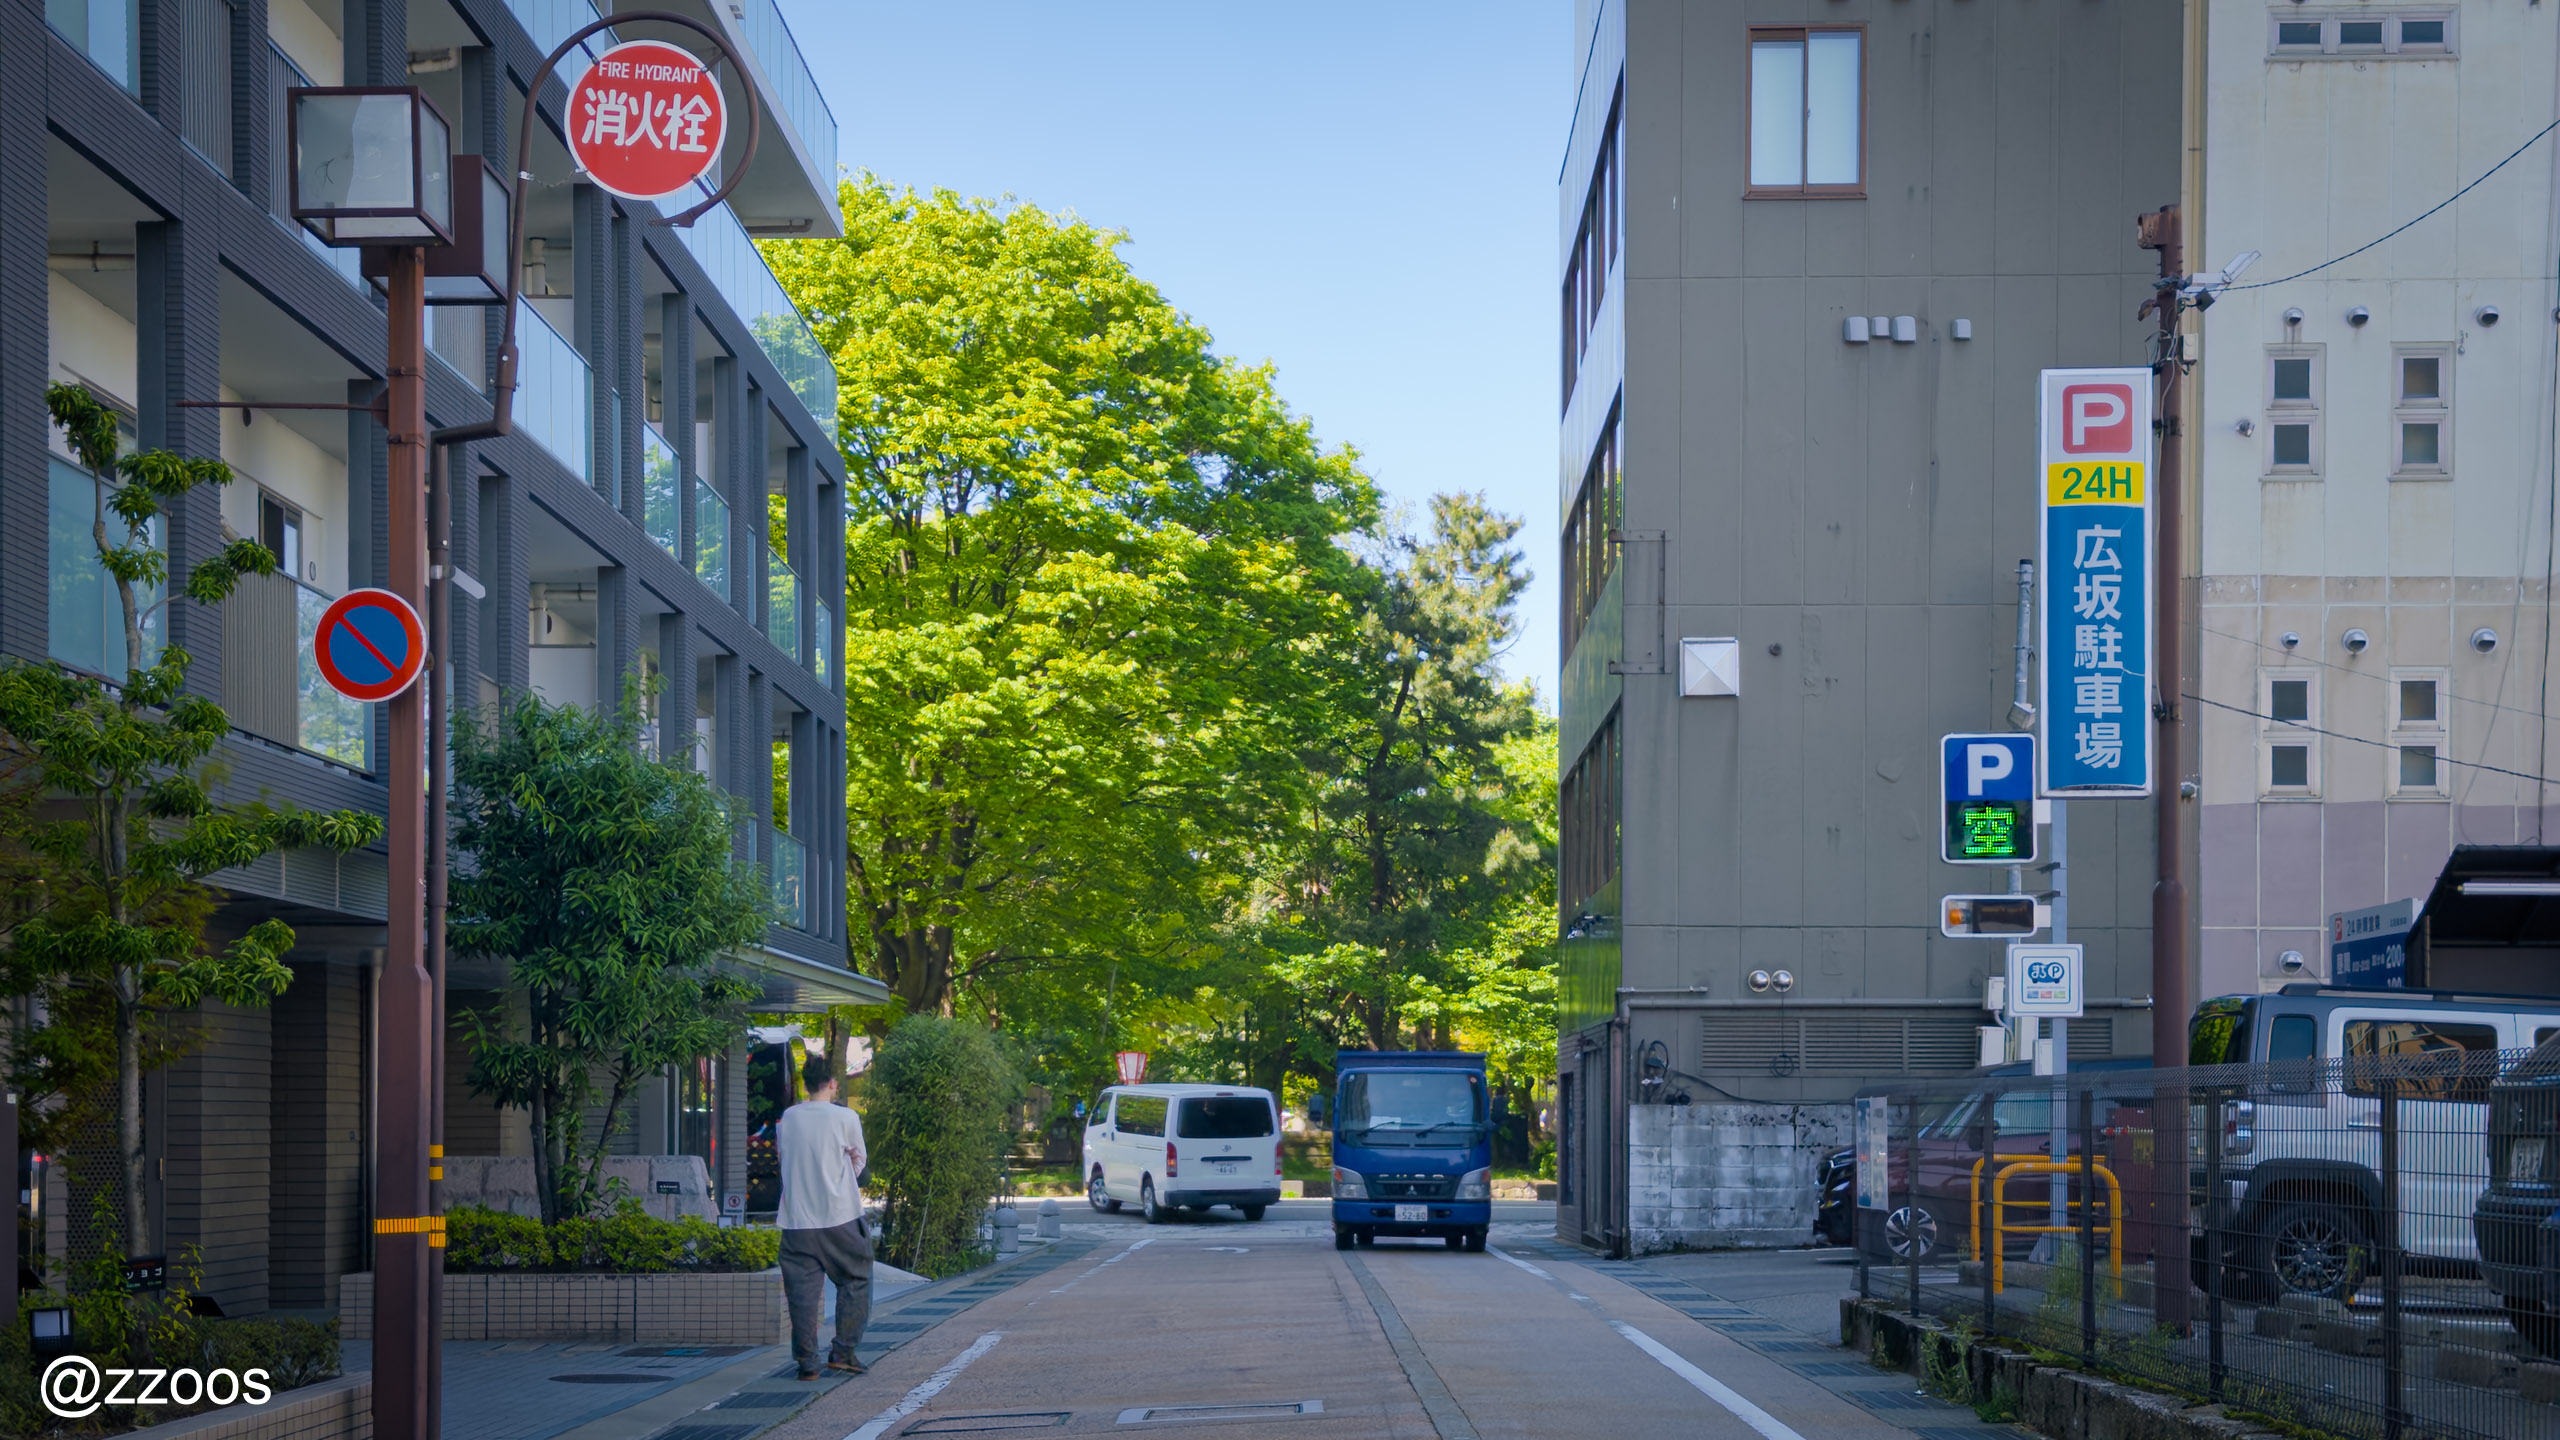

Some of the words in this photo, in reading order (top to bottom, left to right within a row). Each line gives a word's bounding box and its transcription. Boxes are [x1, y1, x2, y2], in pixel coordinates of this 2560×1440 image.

[599, 61, 630, 78] FIRE
[635, 64, 701, 83] HYDRANT
[581, 87, 712, 153] 消火栓
[2072, 392, 2126, 445] P
[2062, 466, 2132, 500] 24H
[2073, 523, 2123, 769] 広坂駐車場
[1967, 743, 2014, 796] P
[1964, 806, 2015, 855] 空
